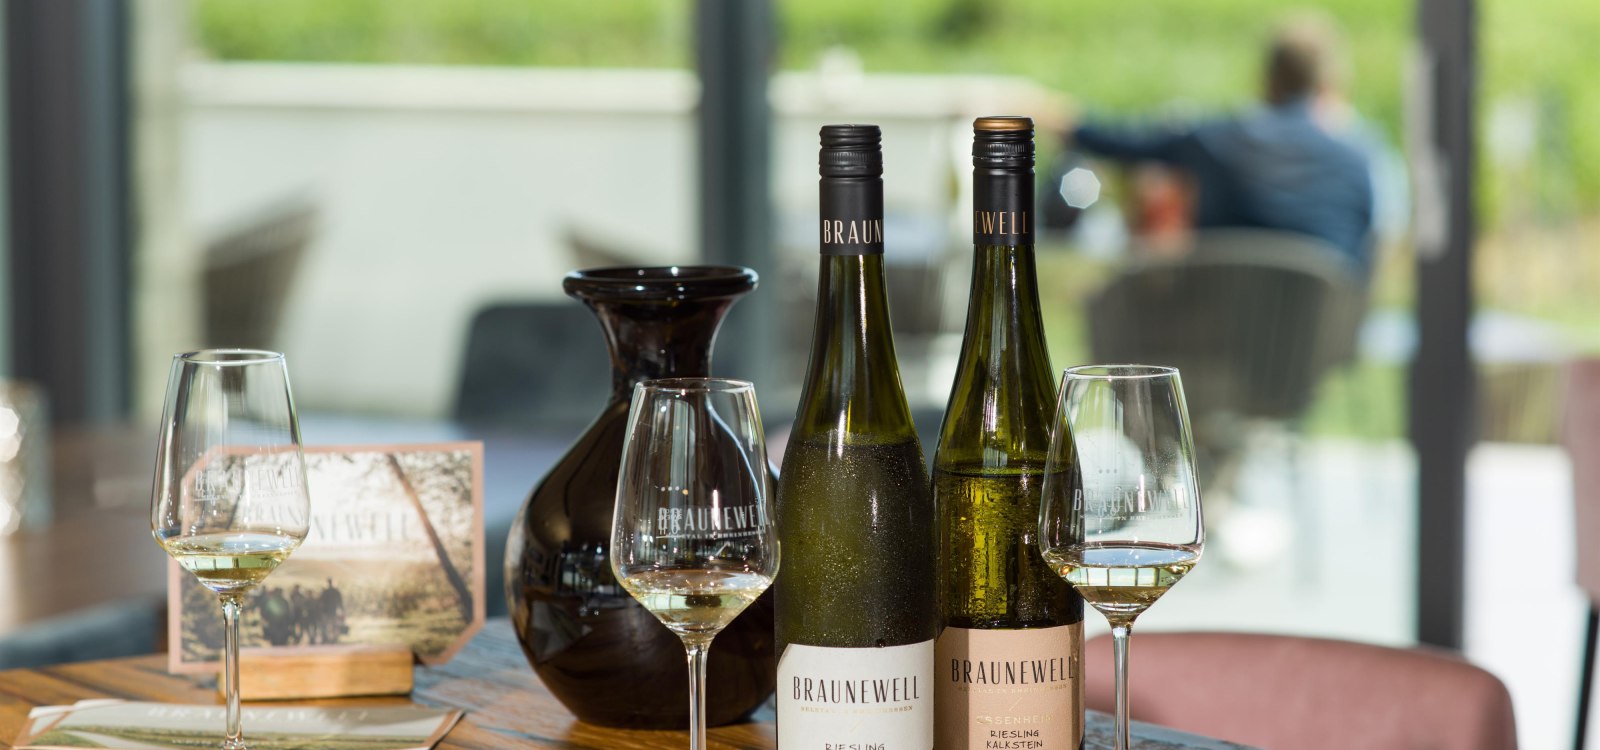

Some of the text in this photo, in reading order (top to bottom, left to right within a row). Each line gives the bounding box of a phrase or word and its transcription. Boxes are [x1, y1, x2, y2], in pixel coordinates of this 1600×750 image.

[824, 219, 881, 244] BRAUN
[975, 211, 1029, 235] EWELL
[951, 656, 1074, 685] BRAUNEWELL
[793, 675, 919, 704] BRAUNEWELL
[986, 740, 1043, 749] KALKSTEIN
[990, 730, 1040, 738] RIESLING
